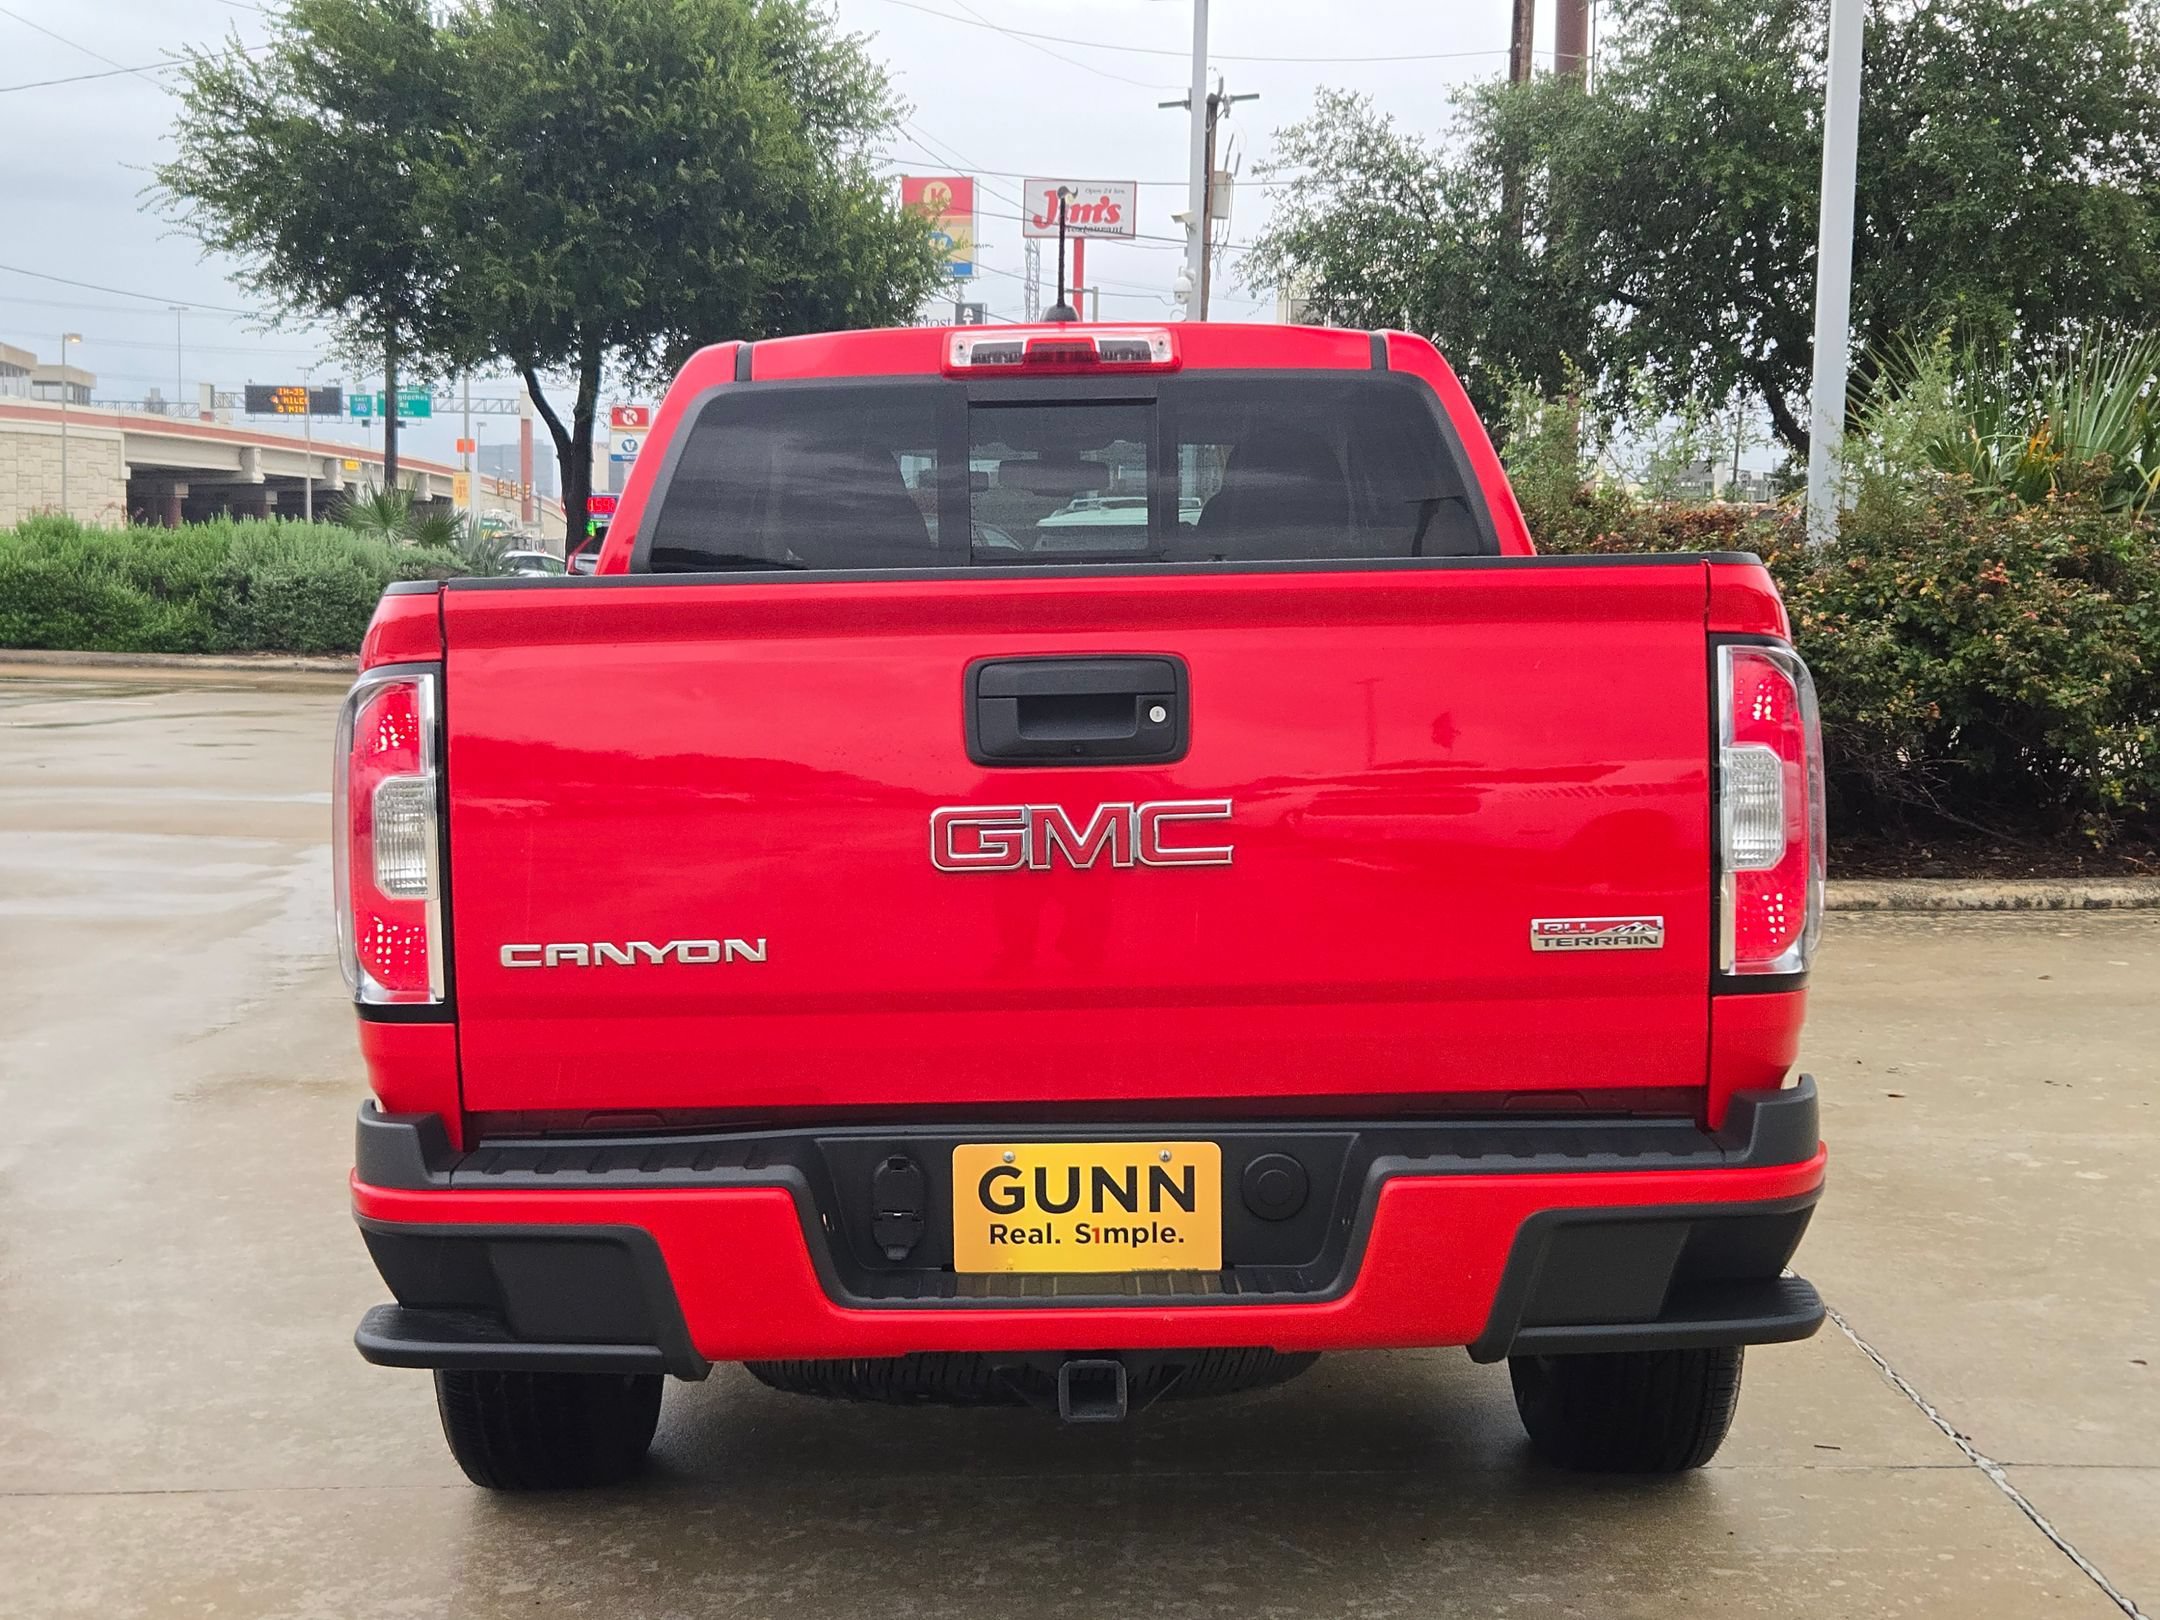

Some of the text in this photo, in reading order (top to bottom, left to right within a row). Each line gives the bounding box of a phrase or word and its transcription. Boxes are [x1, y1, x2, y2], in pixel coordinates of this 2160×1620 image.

[288, 404, 305, 412] MIN
[929, 799, 1234, 872] GMC
[1543, 922, 1596, 934] ALL
[500, 938, 767, 968] CANYON
[1538, 936, 1659, 948] TERRAIN
[977, 1164, 1196, 1215] GUNN
[989, 1222, 1061, 1245] Real.
